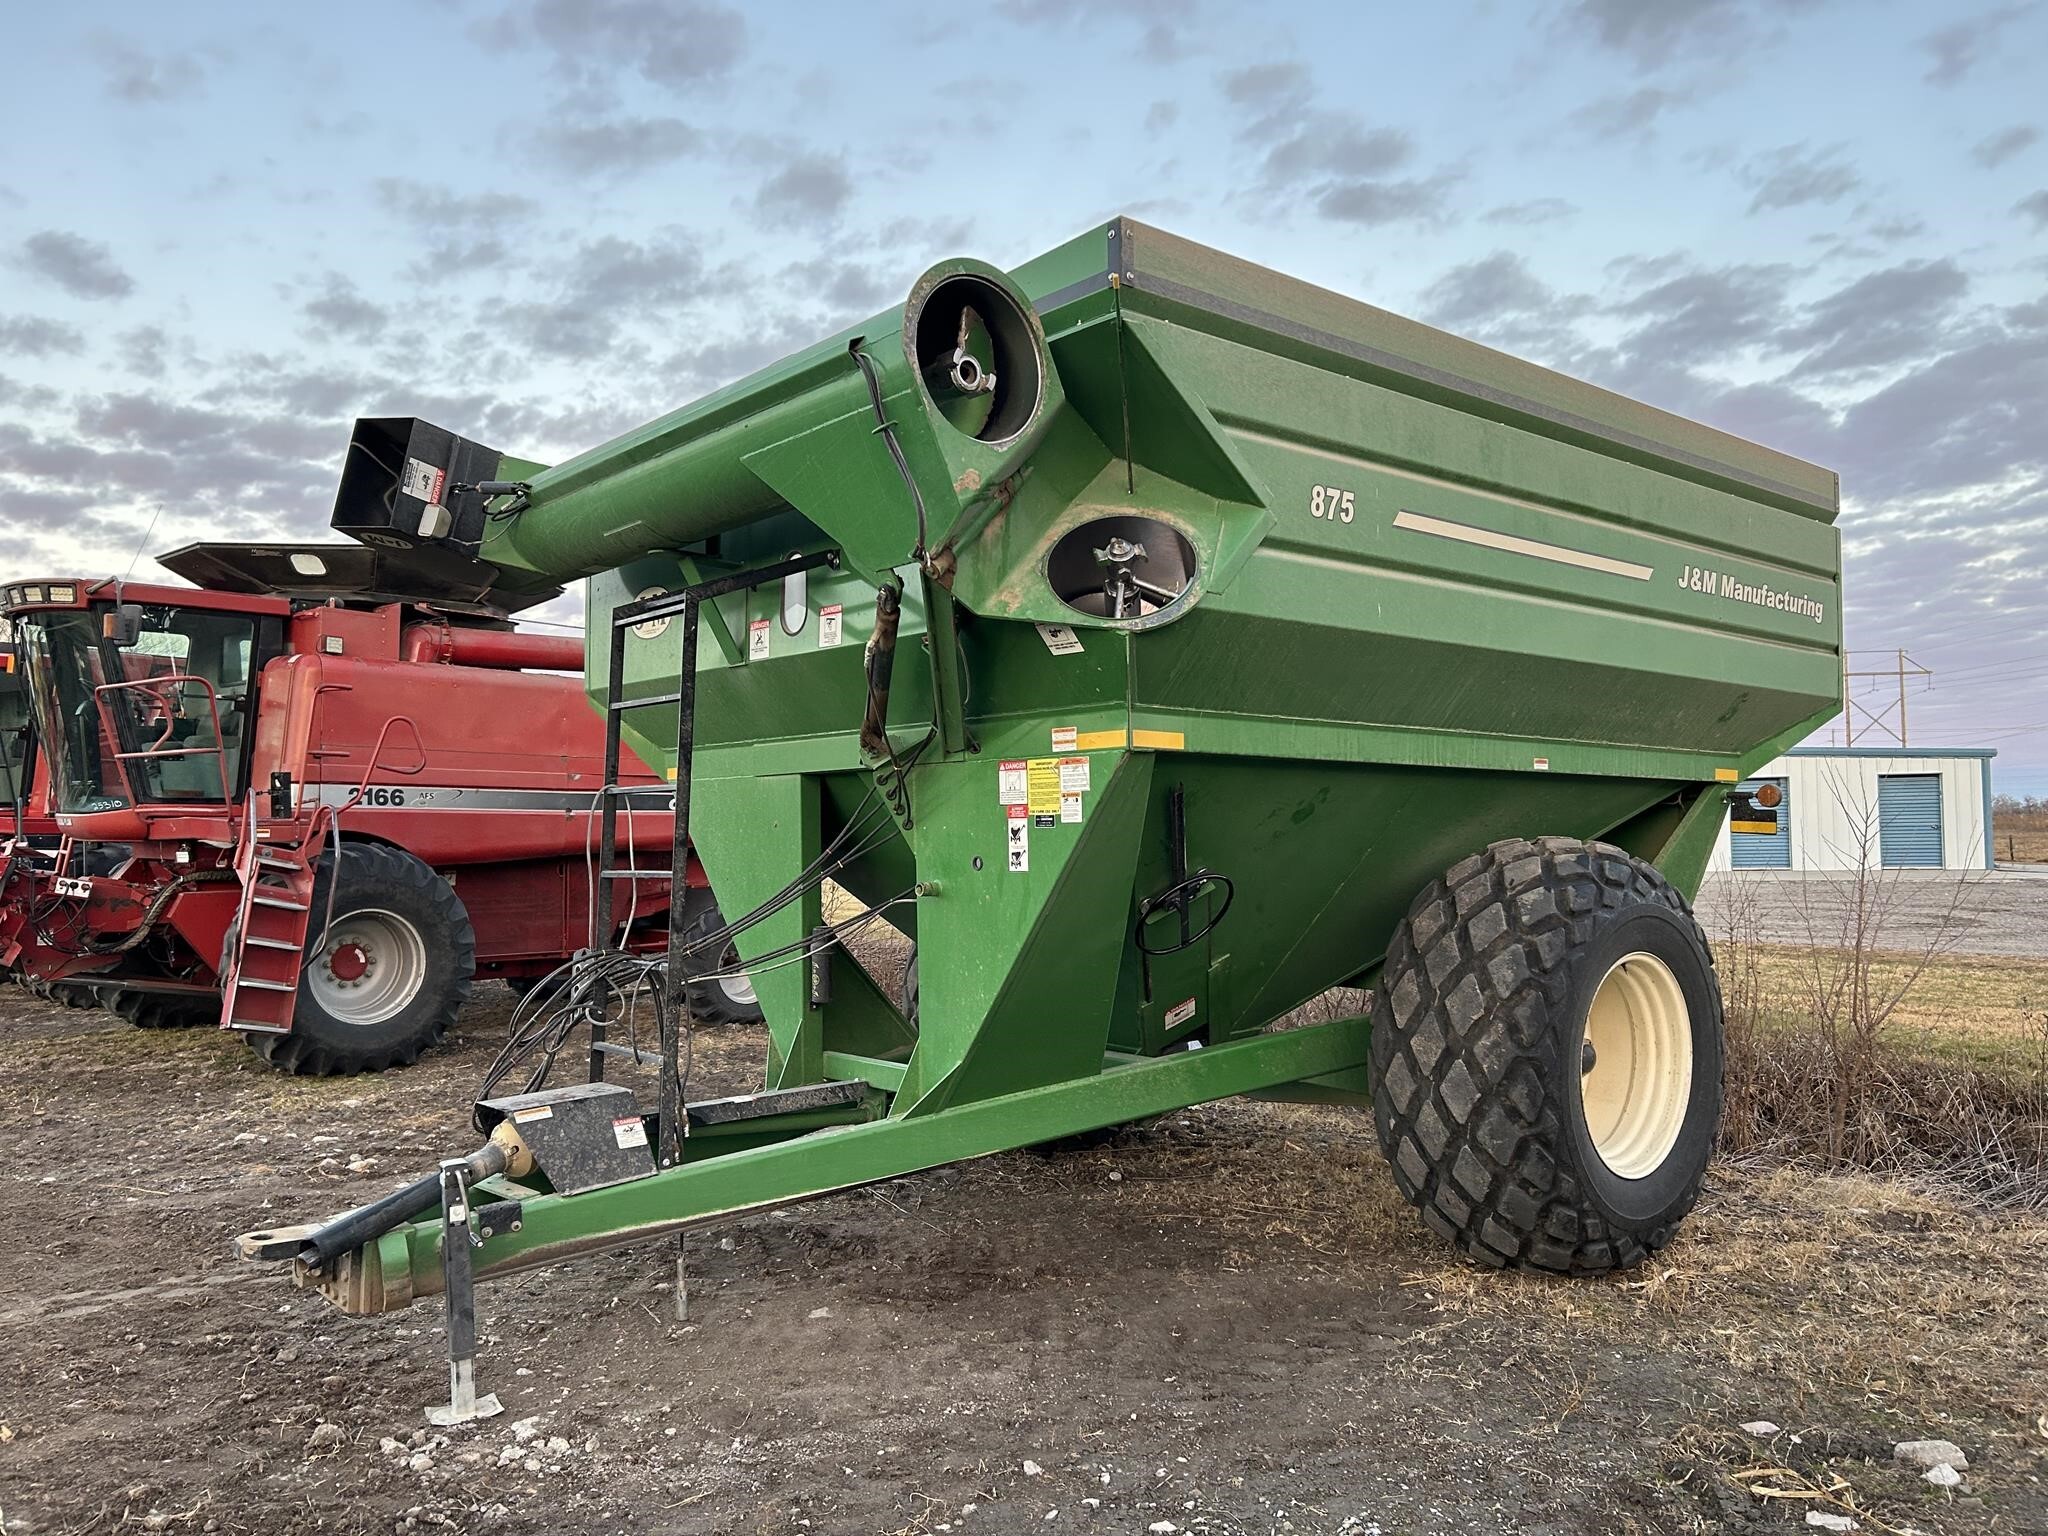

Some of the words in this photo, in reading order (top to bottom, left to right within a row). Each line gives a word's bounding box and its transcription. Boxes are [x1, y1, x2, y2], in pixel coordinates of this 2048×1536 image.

[1310, 484, 1355, 524] 875
[1678, 565, 1717, 595] J&M
[1720, 574, 1824, 624] Manufacturing
[1006, 762, 1026, 770] DANGER
[348, 787, 405, 807] 2166
[419, 792, 435, 800] AFS
[619, 1117, 640, 1125] DANGER
